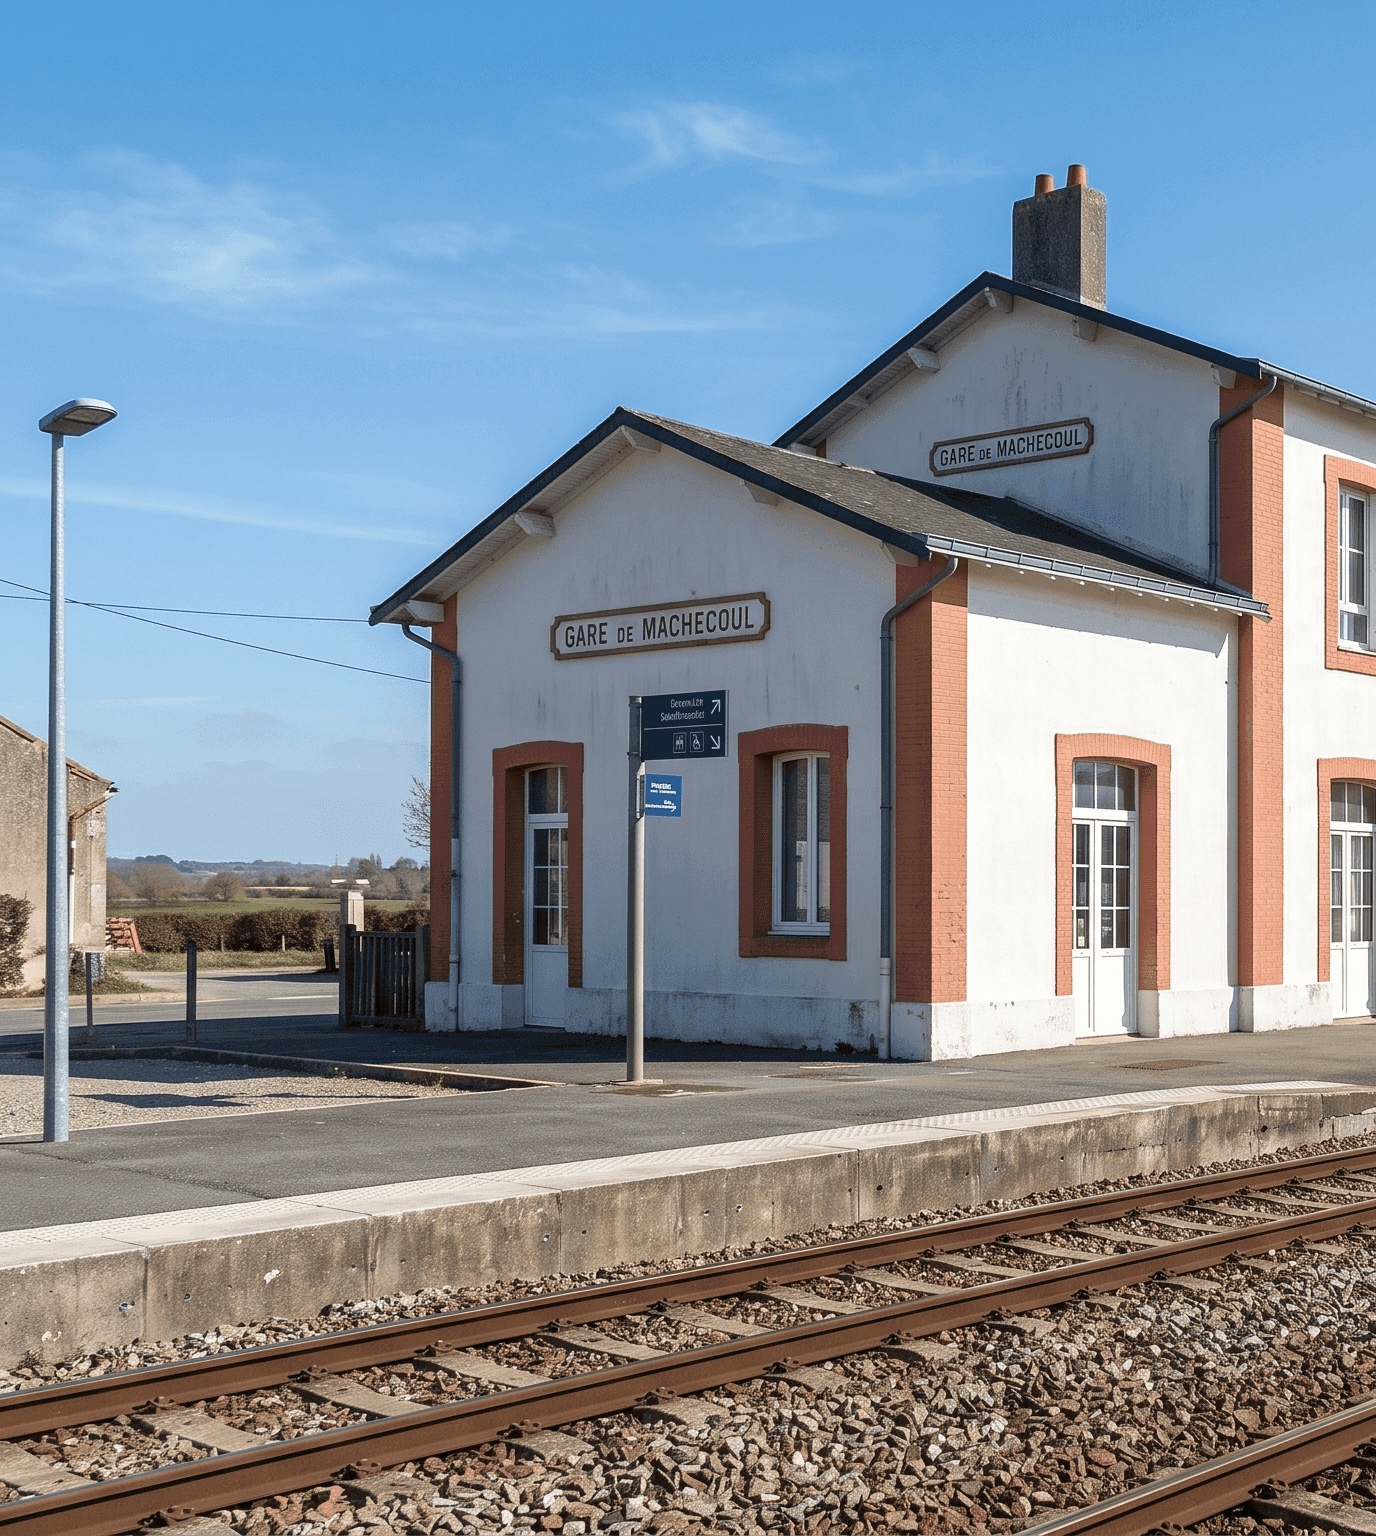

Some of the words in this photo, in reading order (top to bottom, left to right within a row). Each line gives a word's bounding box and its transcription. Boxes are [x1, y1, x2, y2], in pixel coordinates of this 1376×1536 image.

[940, 445, 976, 466] GARE
[979, 448, 992, 461] DE
[997, 428, 1083, 458] MACHECOUL
[565, 622, 608, 648] GARE
[617, 626, 634, 643] DE
[642, 606, 755, 641] MACHECOUL
